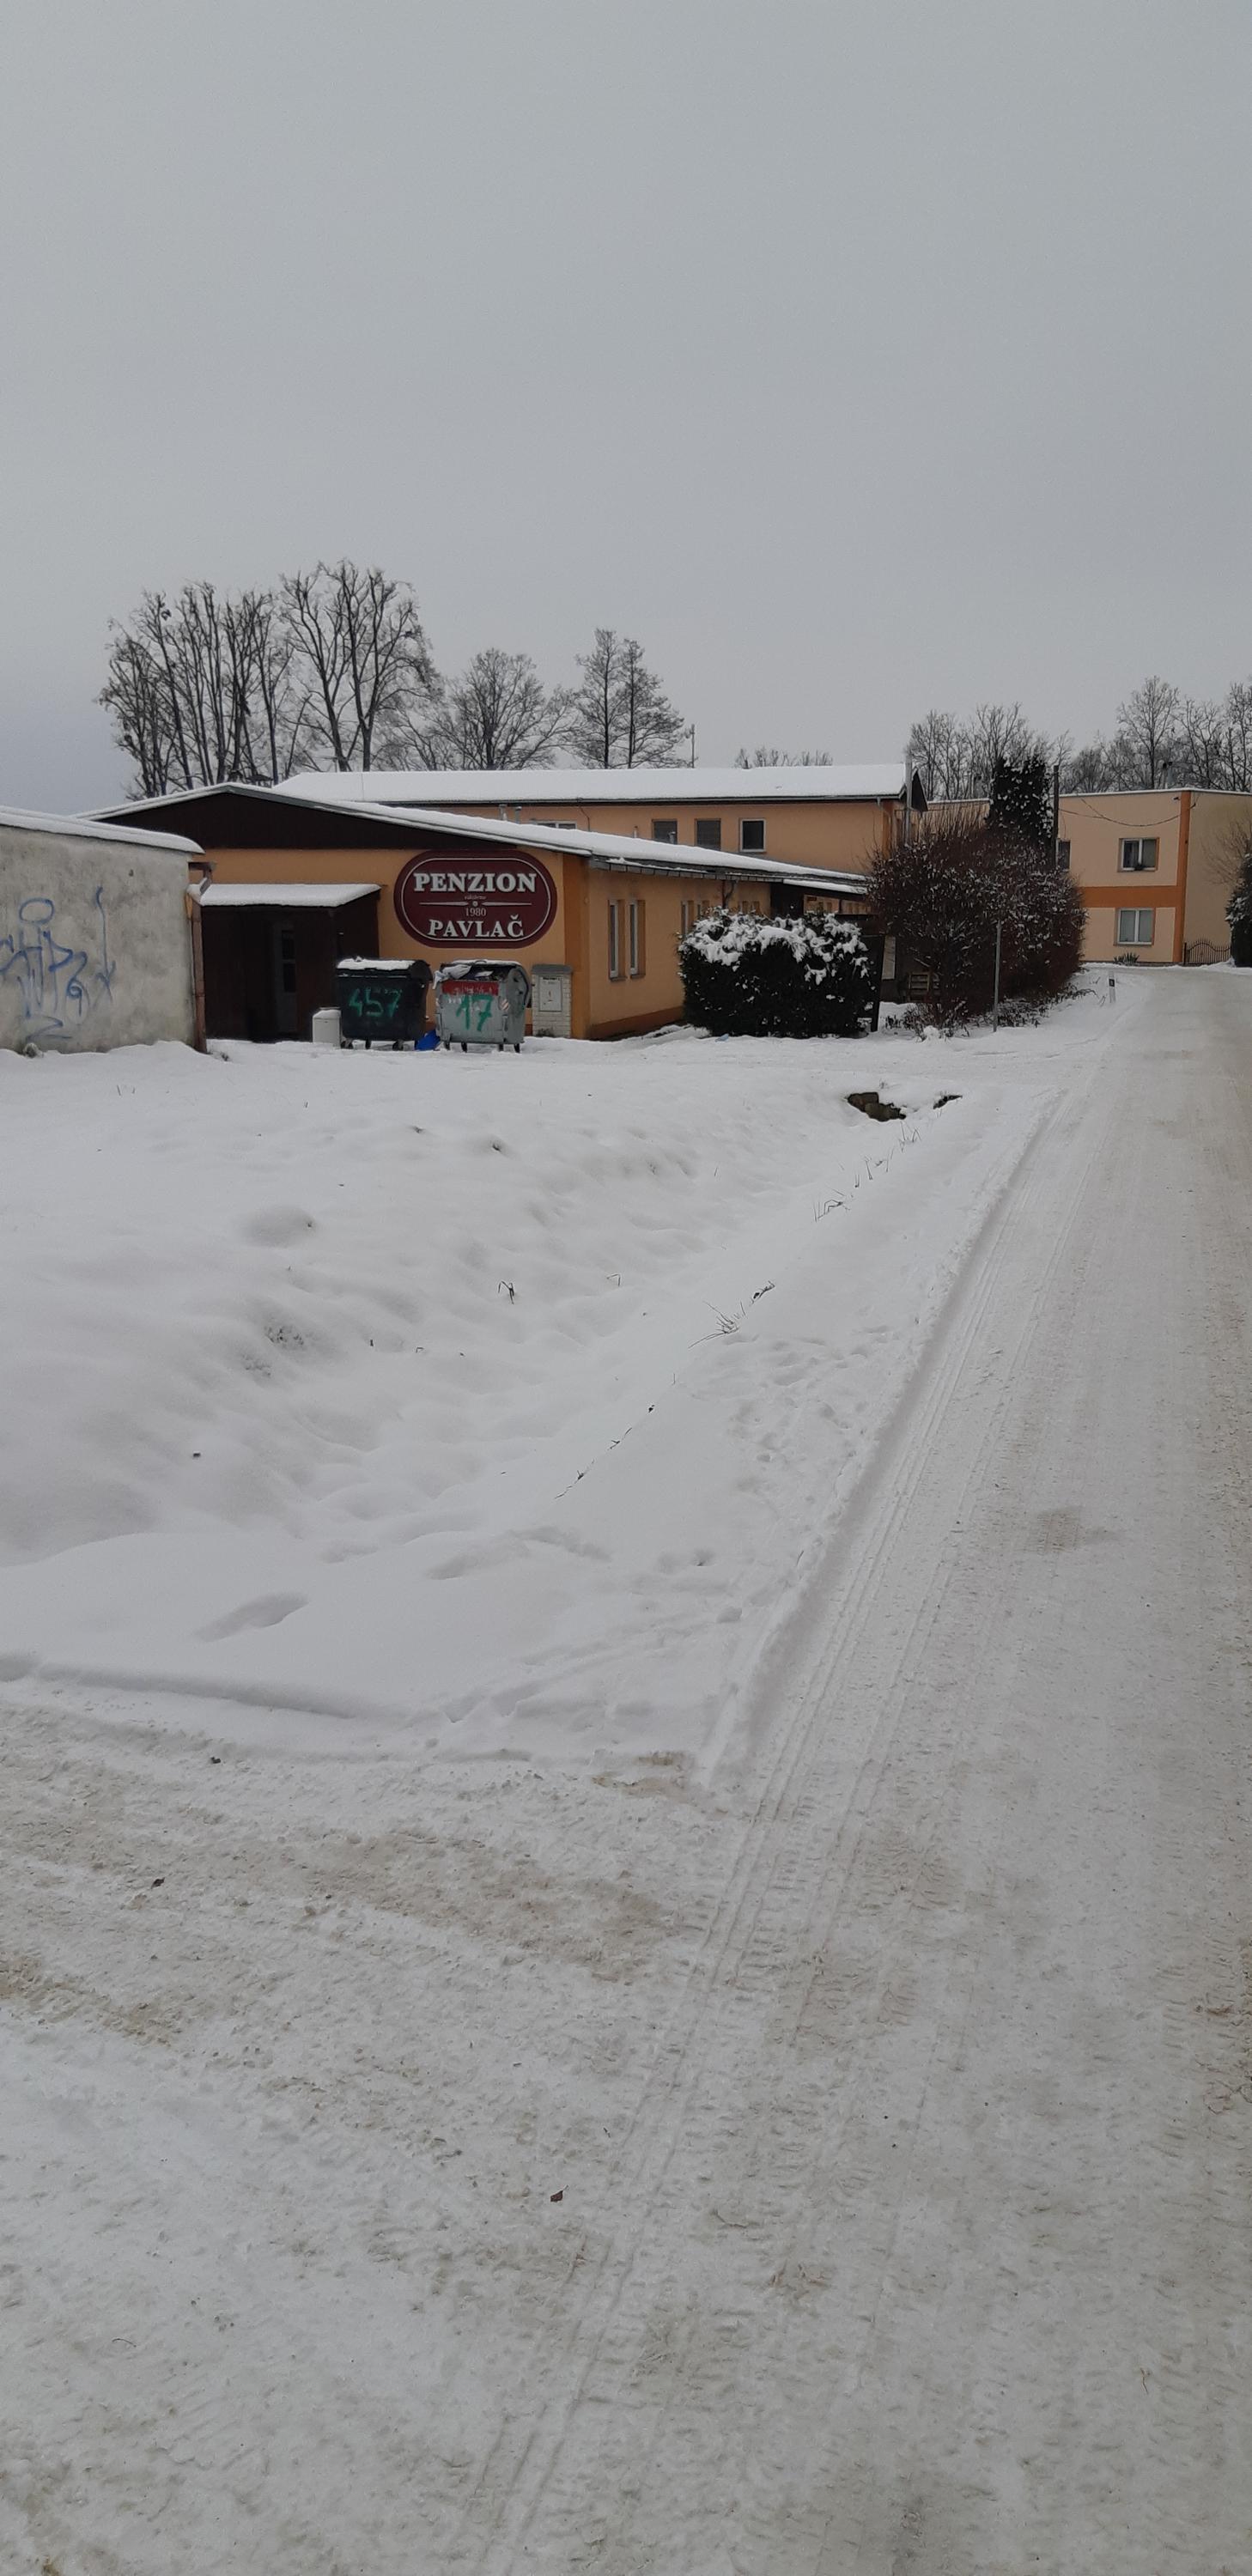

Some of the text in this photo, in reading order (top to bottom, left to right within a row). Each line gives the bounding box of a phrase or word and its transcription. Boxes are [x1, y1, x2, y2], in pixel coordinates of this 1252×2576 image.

[413, 872, 537, 892] PENZION
[465, 907, 487, 916] 1980
[427, 914, 524, 938] PAVLAČ
[349, 987, 403, 1018] 457
